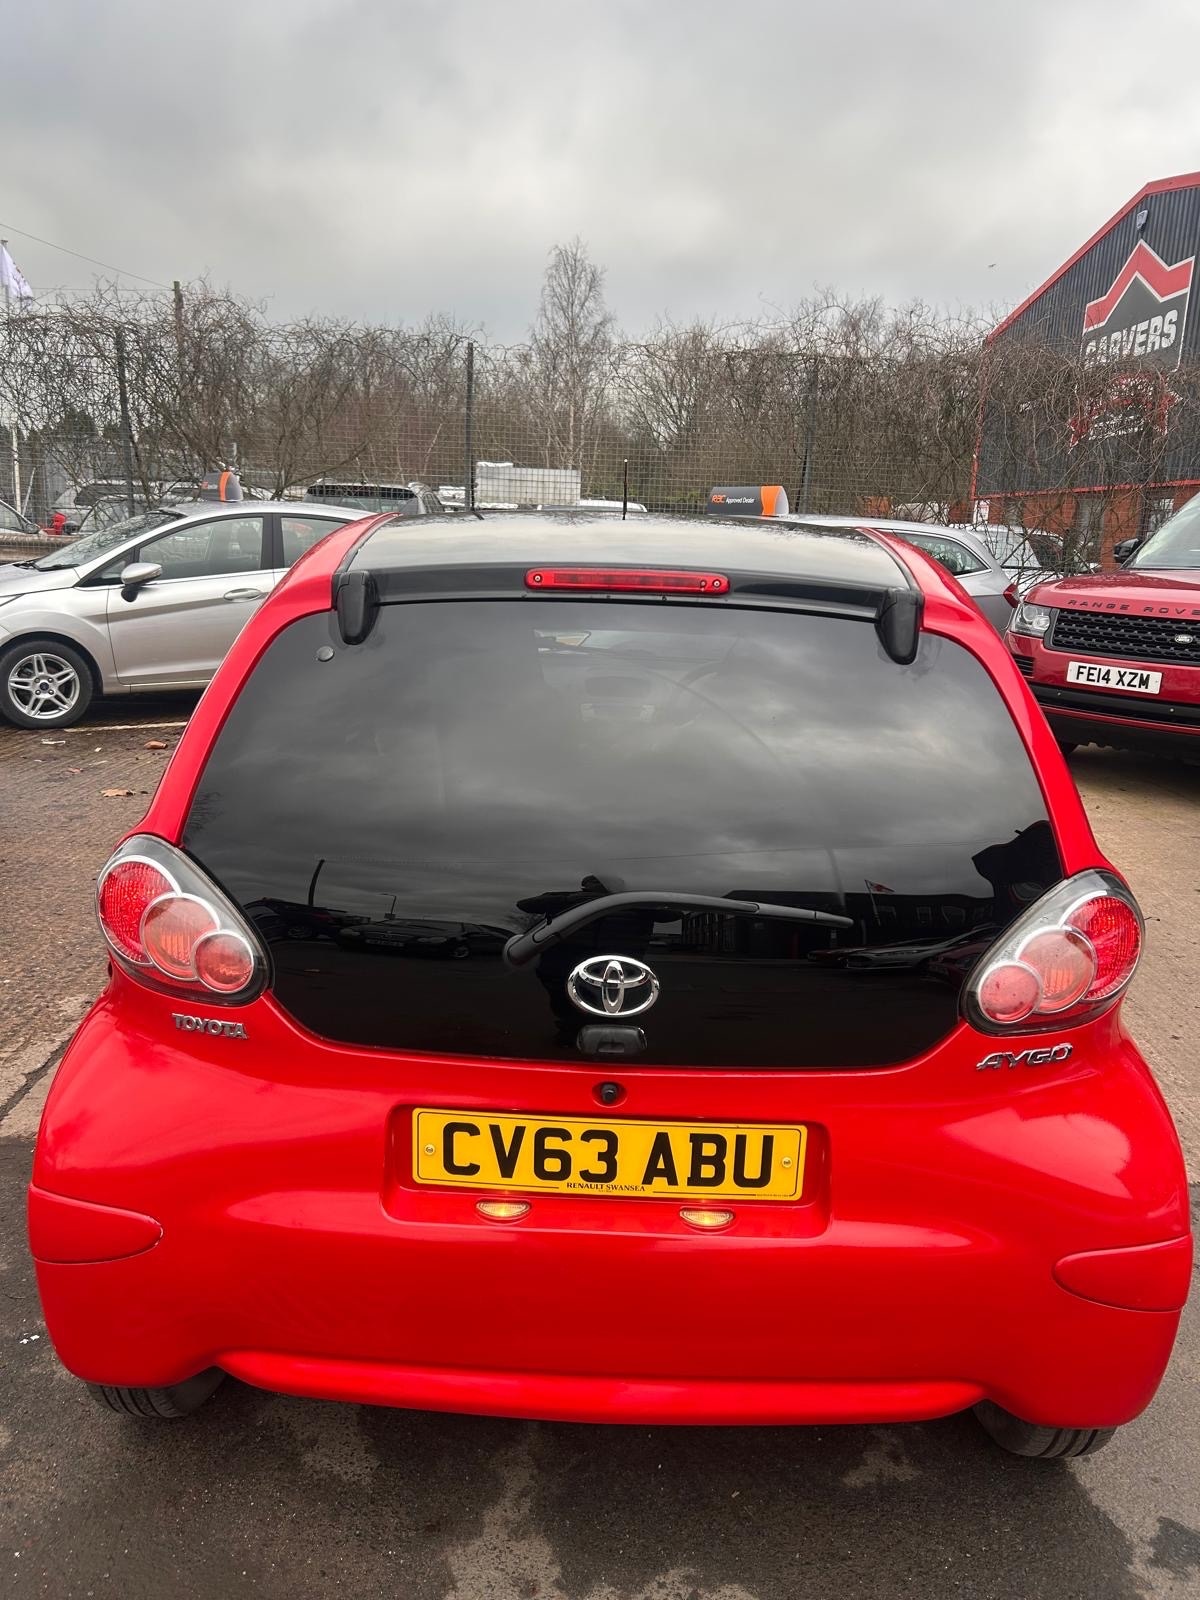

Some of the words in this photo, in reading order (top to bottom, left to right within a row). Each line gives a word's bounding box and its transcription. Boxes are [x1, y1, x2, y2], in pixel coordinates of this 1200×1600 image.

[742, 496, 755, 504] Dealer
[1067, 599, 1130, 610] RANGE
[1143, 606, 1200, 615] ROVE
[1076, 665, 1111, 685] FE14
[1115, 670, 1151, 690] XZM
[171, 1012, 248, 1039] TOYOTA
[976, 1042, 1073, 1070] AYGO
[442, 1122, 619, 1183] CV63
[642, 1131, 774, 1187] ABU
[566, 1182, 604, 1190] RENAULT
[605, 1184, 646, 1192] SWANSEA
